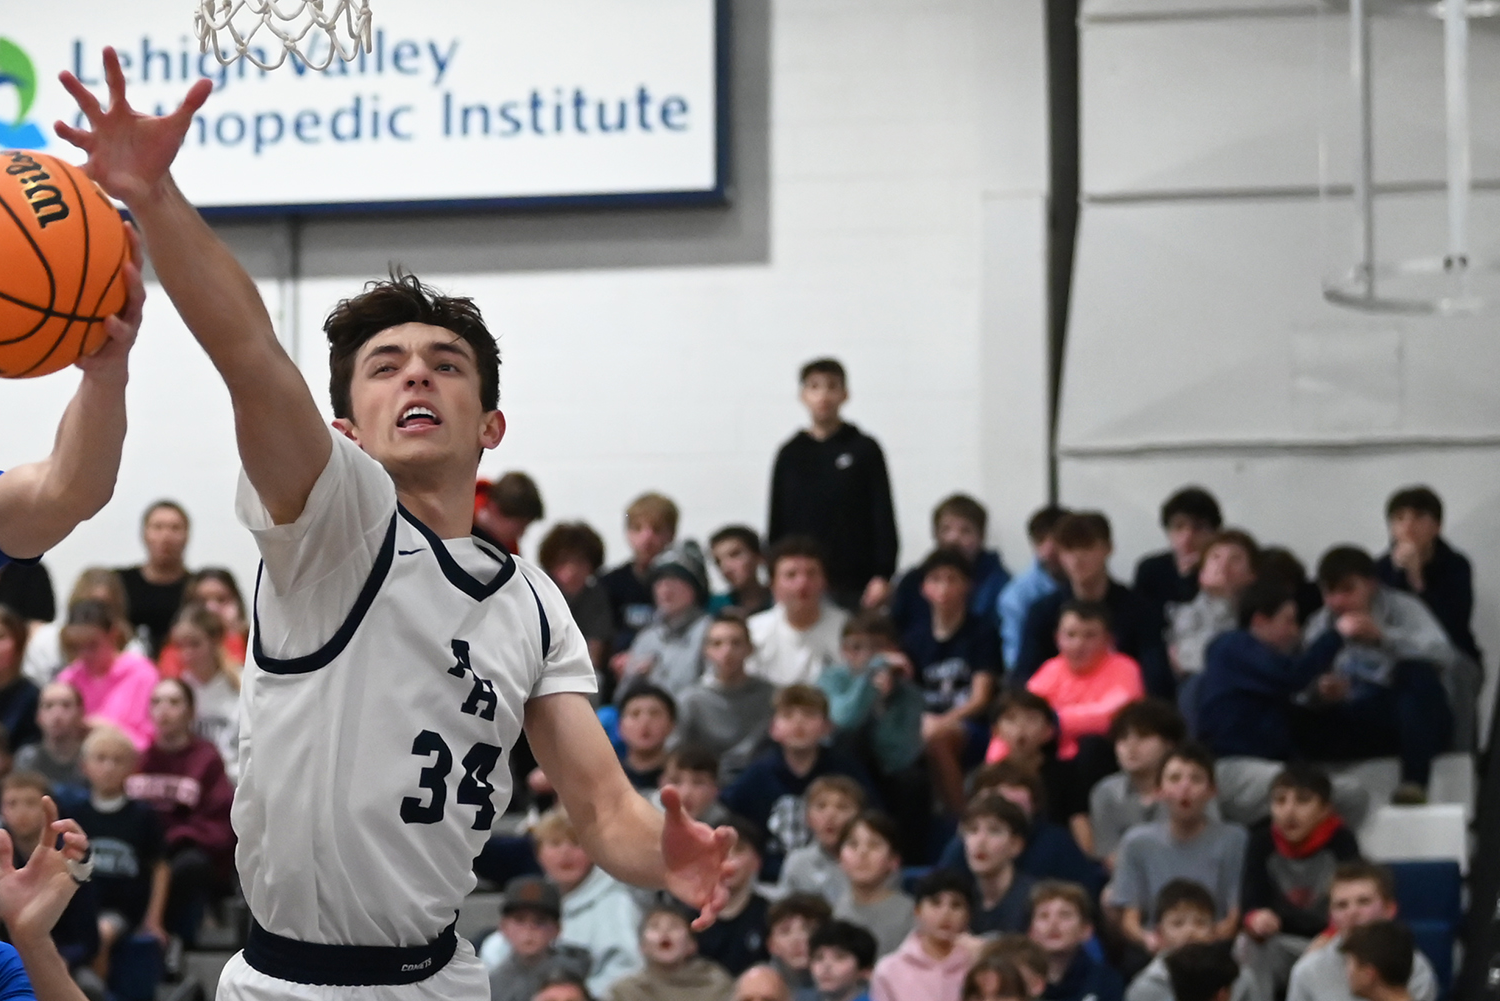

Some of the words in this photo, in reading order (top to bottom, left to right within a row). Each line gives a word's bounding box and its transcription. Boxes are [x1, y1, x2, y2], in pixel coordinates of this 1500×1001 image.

[283, 28, 459, 86] Valley
[74, 96, 414, 154] hopedic
[443, 84, 689, 137] Institute
[1, 150, 70, 229] Wils
[400, 729, 502, 831] 34
